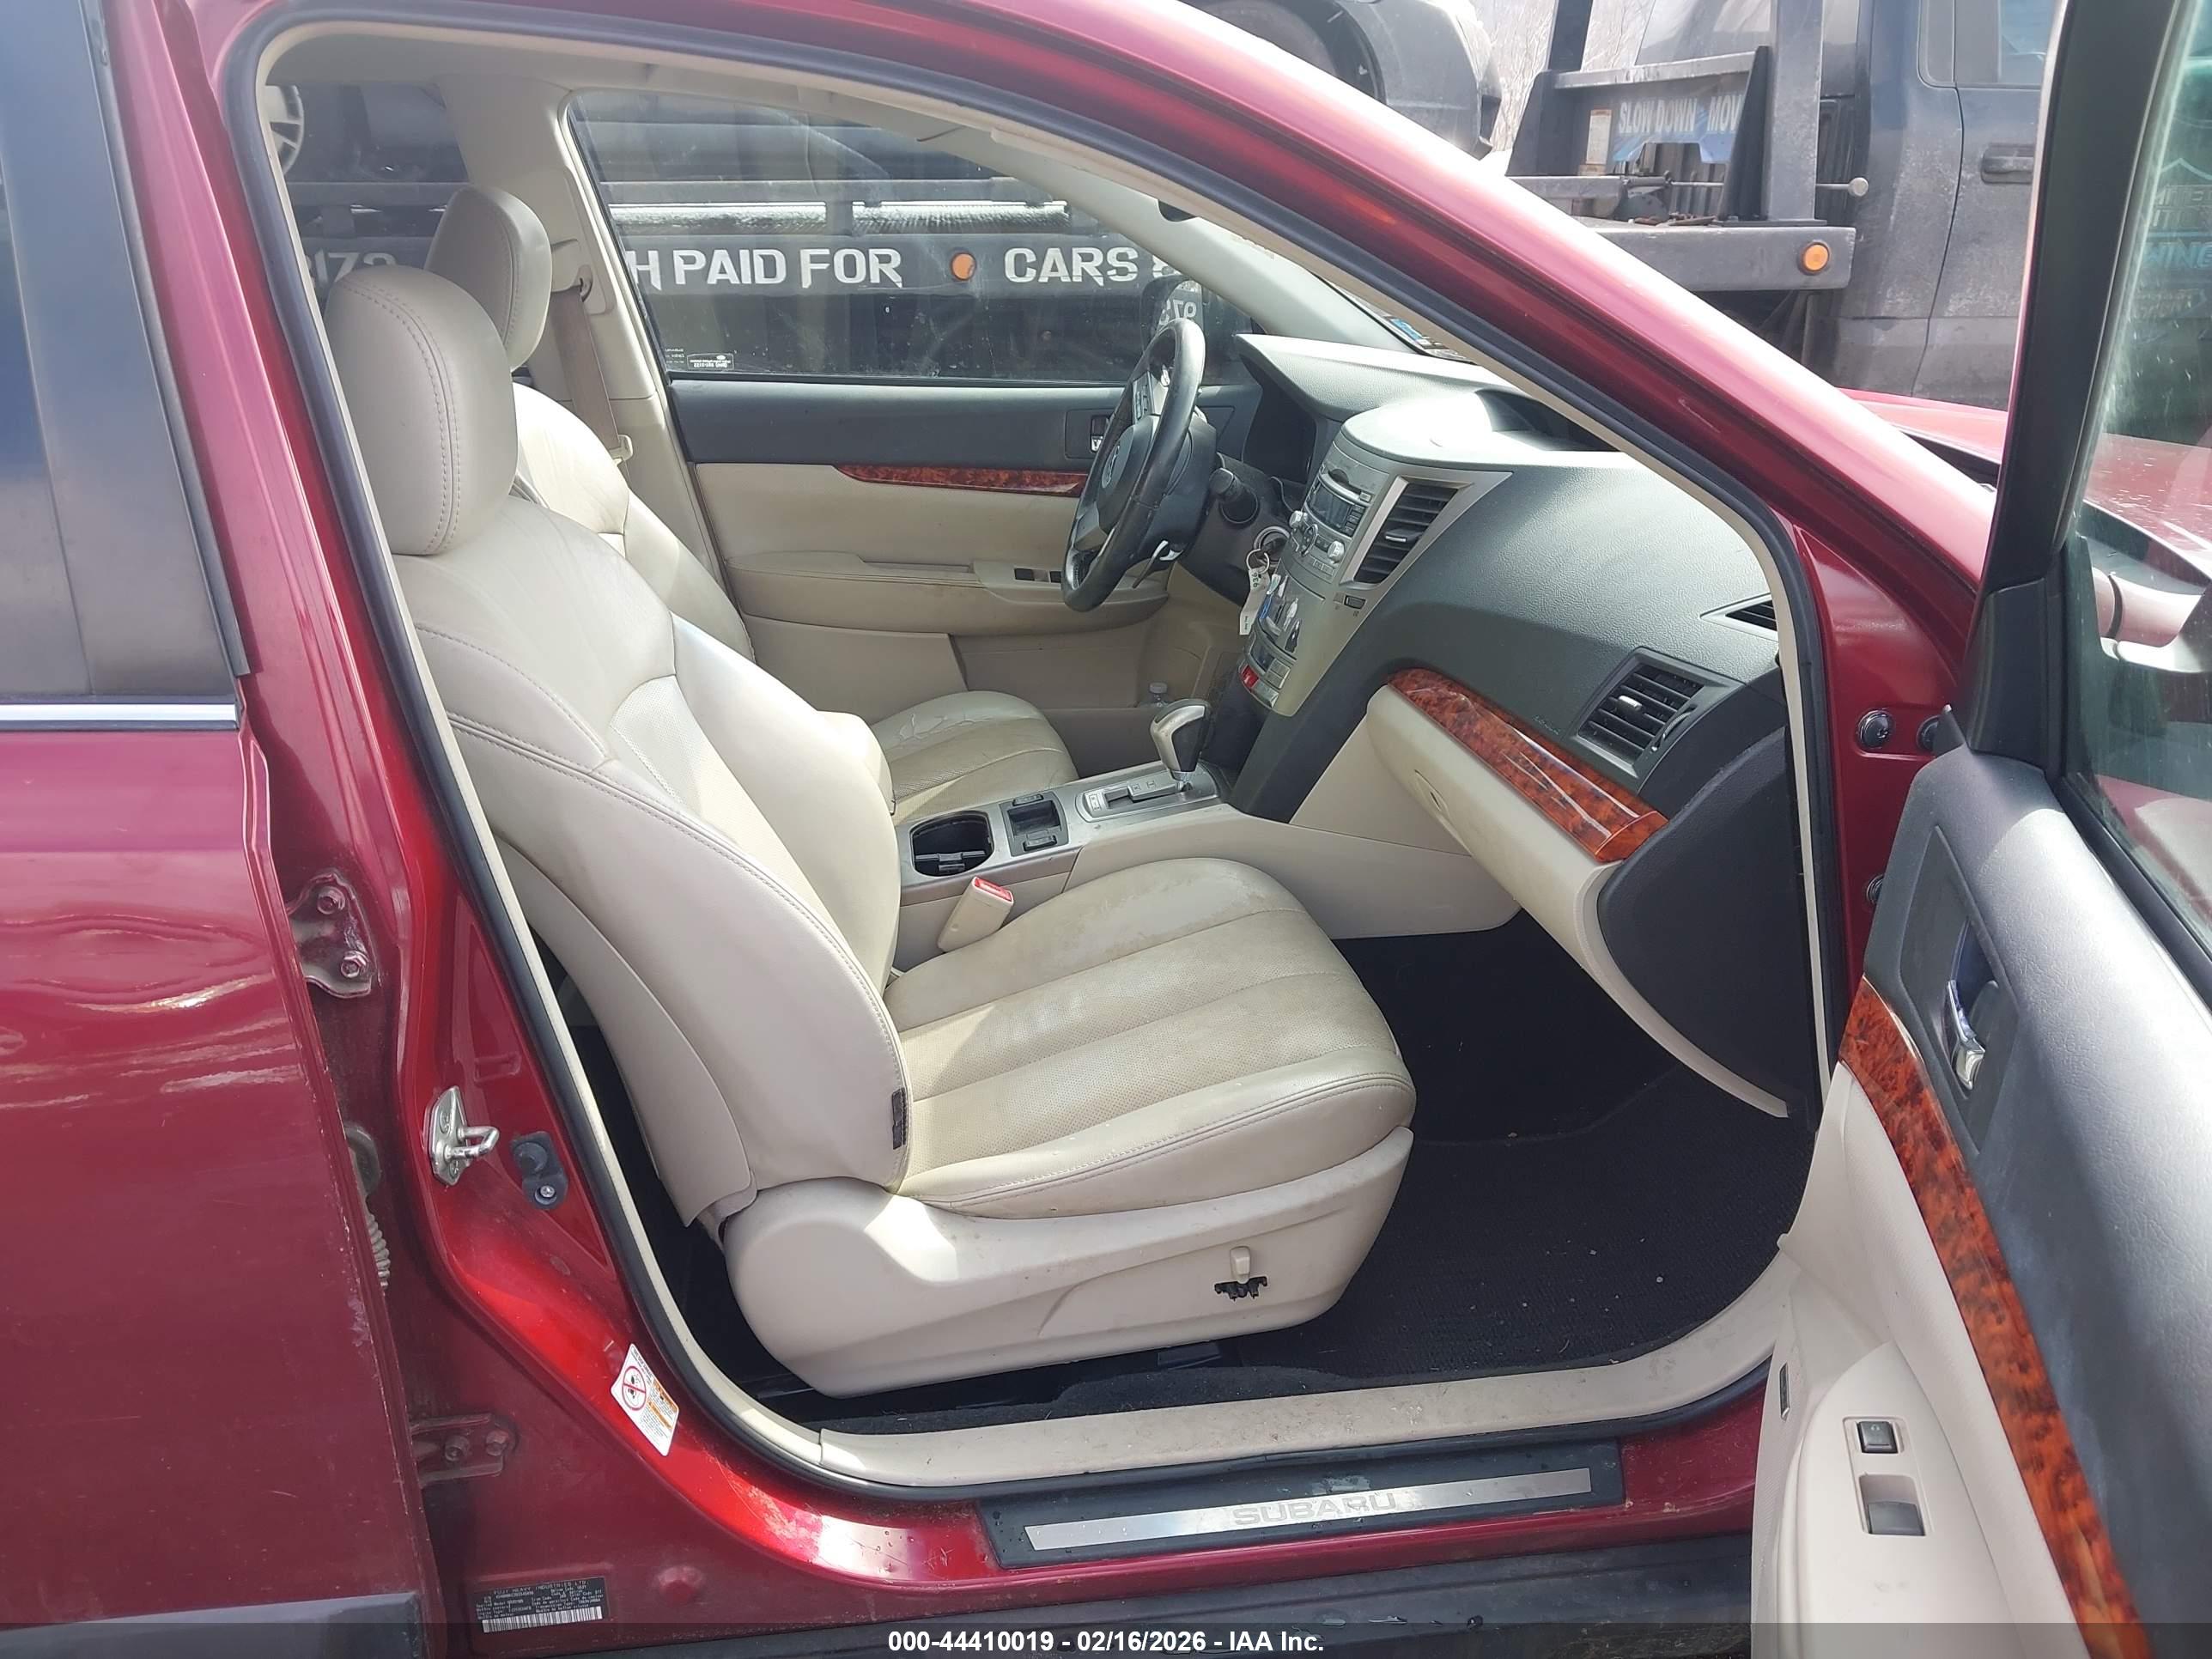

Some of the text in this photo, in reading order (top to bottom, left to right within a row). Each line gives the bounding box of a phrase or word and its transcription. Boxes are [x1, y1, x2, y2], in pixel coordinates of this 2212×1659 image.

[1620, 101, 1655, 134] SLOW
[1656, 98, 1697, 132] DOWN
[673, 249, 787, 285] PAID
[799, 248, 902, 289] FOR
[1004, 247, 1139, 286] CARS
[1233, 1492, 1396, 1525] SUBARU
